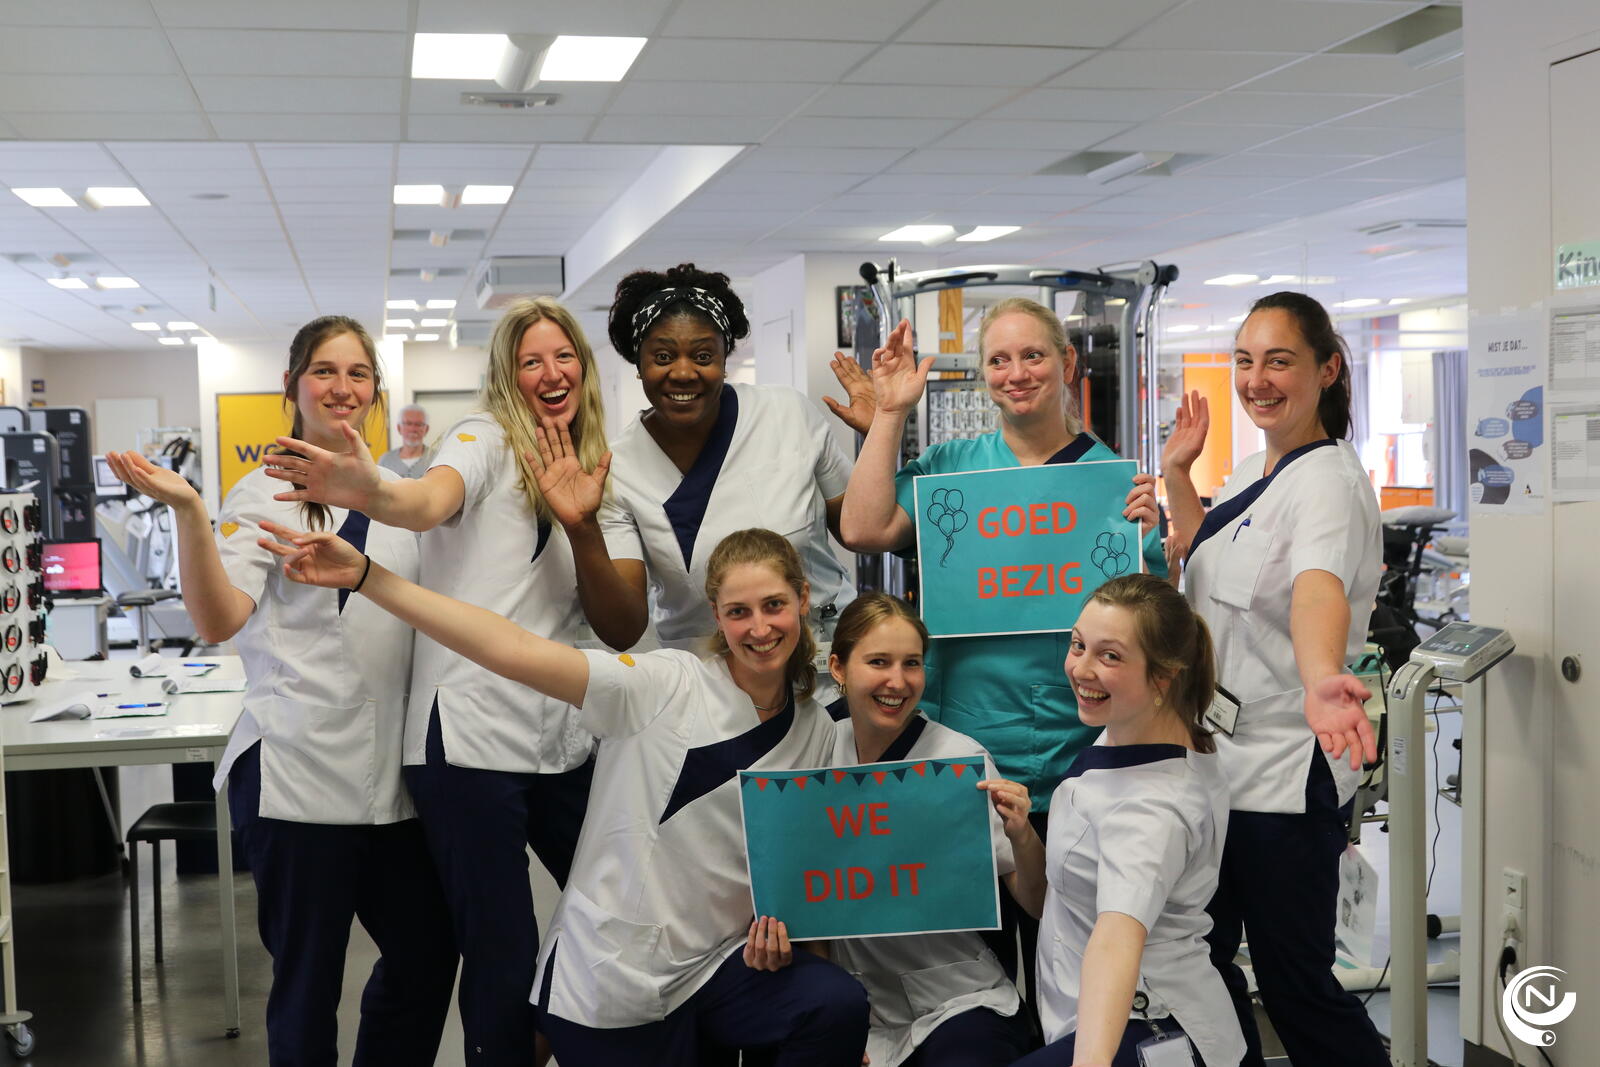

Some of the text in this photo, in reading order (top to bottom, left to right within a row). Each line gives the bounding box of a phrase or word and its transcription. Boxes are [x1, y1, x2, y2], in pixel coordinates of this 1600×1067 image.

[1559, 251, 1600, 280] Kin
[977, 501, 1078, 539] GOED
[977, 561, 1084, 599] BEZIG
[825, 802, 892, 839] WE
[803, 862, 926, 903] DID IT
